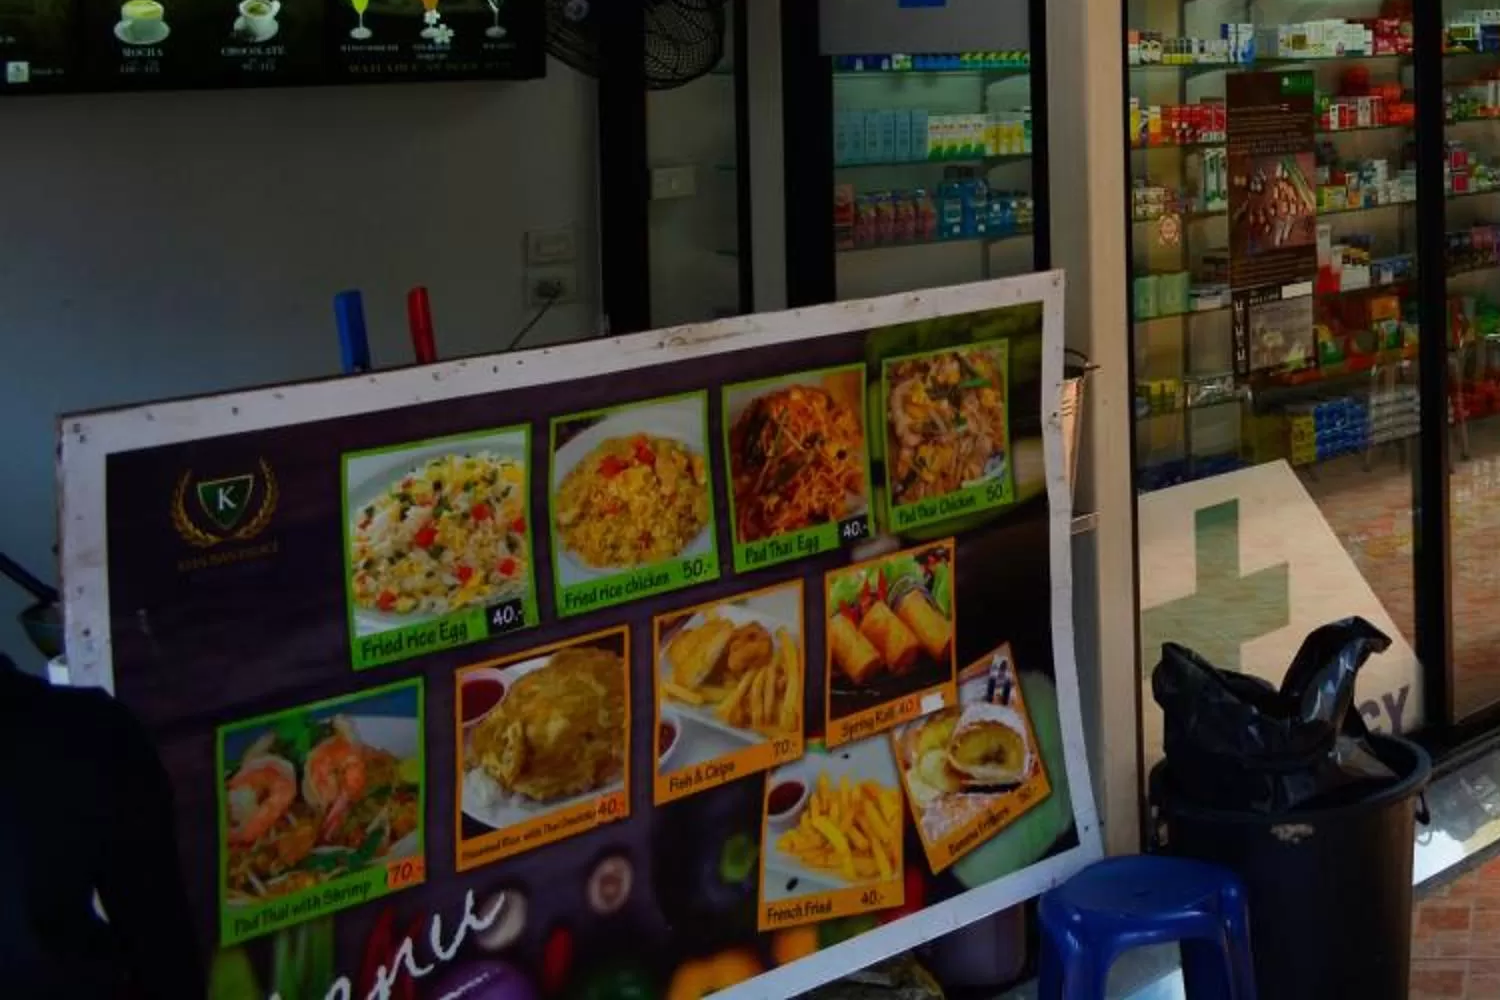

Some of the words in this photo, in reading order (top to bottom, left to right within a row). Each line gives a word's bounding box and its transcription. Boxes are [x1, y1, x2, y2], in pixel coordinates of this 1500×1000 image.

[216, 484, 237, 511] K
[745, 546, 767, 565] Pad
[768, 539, 793, 558] Thai
[797, 533, 820, 551] Egg
[564, 588, 597, 608] Fried
[600, 583, 623, 601] rice
[625, 571, 671, 594] chicken
[361, 633, 402, 661] Fried
[402, 628, 436, 651] rice
[438, 620, 468, 645] Egg
[669, 774, 693, 793] Fish
[705, 759, 736, 781] Chips
[234, 915, 259, 937] Pad
[256, 903, 290, 923] Thai
[292, 895, 321, 916] with
[323, 879, 373, 905] Shrimp
[767, 904, 803, 926] French
[804, 897, 833, 917] Fried
[268, 888, 506, 1000] nu
